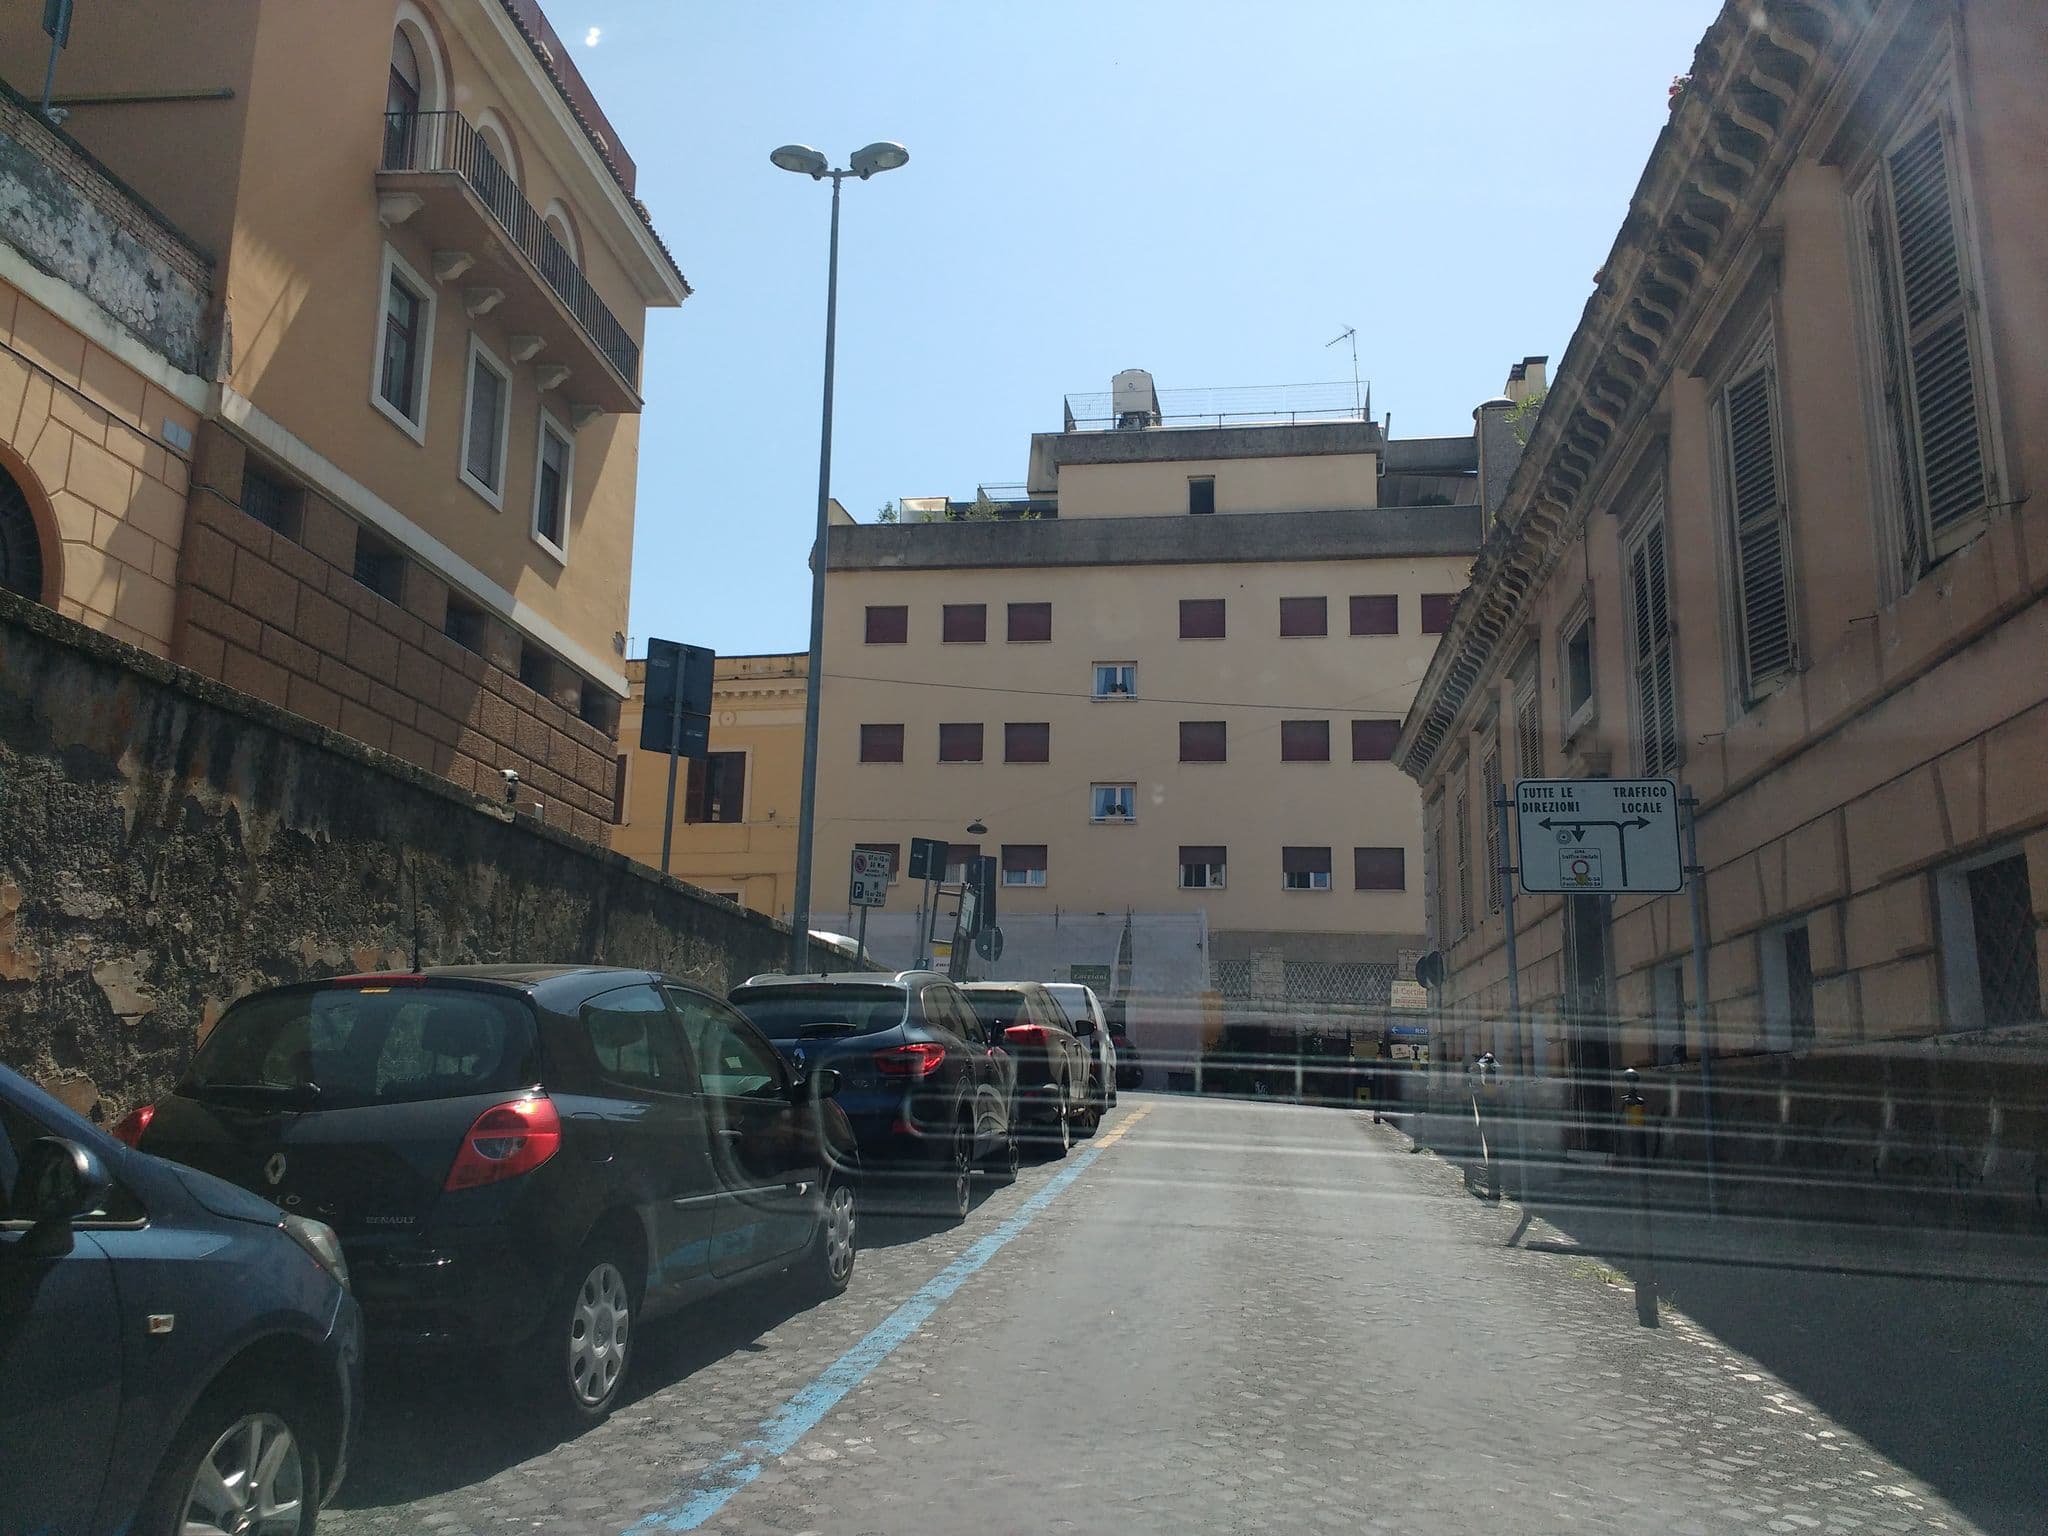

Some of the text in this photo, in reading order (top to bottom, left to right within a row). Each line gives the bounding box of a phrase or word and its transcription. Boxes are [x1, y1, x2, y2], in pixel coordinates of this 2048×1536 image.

[1522, 787, 1573, 798] TUTTE LE
[1613, 787, 1667, 798] TRAFFICO
[1522, 801, 1580, 813] DIREZIONI
[1622, 802, 1662, 813] LOCALE
[365, 1216, 417, 1224] RENAULT
